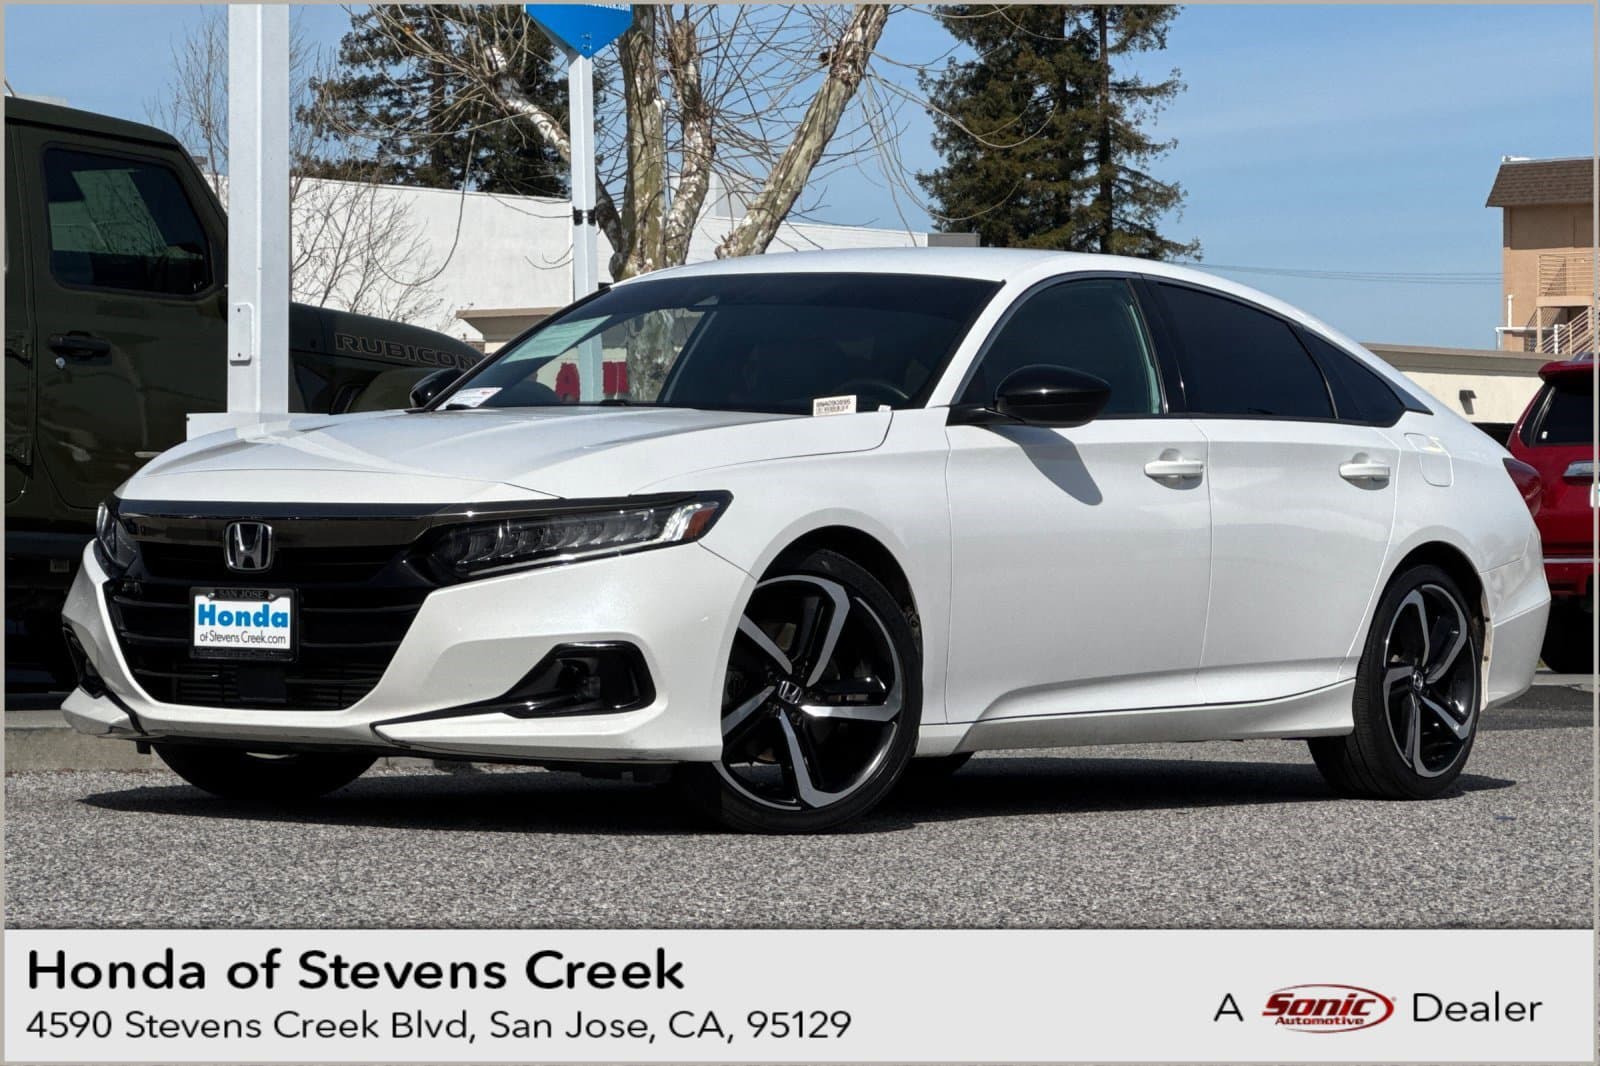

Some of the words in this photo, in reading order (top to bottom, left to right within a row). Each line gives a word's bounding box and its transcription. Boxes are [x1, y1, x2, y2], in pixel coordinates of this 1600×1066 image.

[220, 590, 238, 599] SAN
[241, 590, 265, 599] JOSE
[198, 604, 288, 628] Honda
[199, 632, 208, 642] of
[209, 629, 240, 643] Stevens
[241, 630, 286, 644] Creek.com
